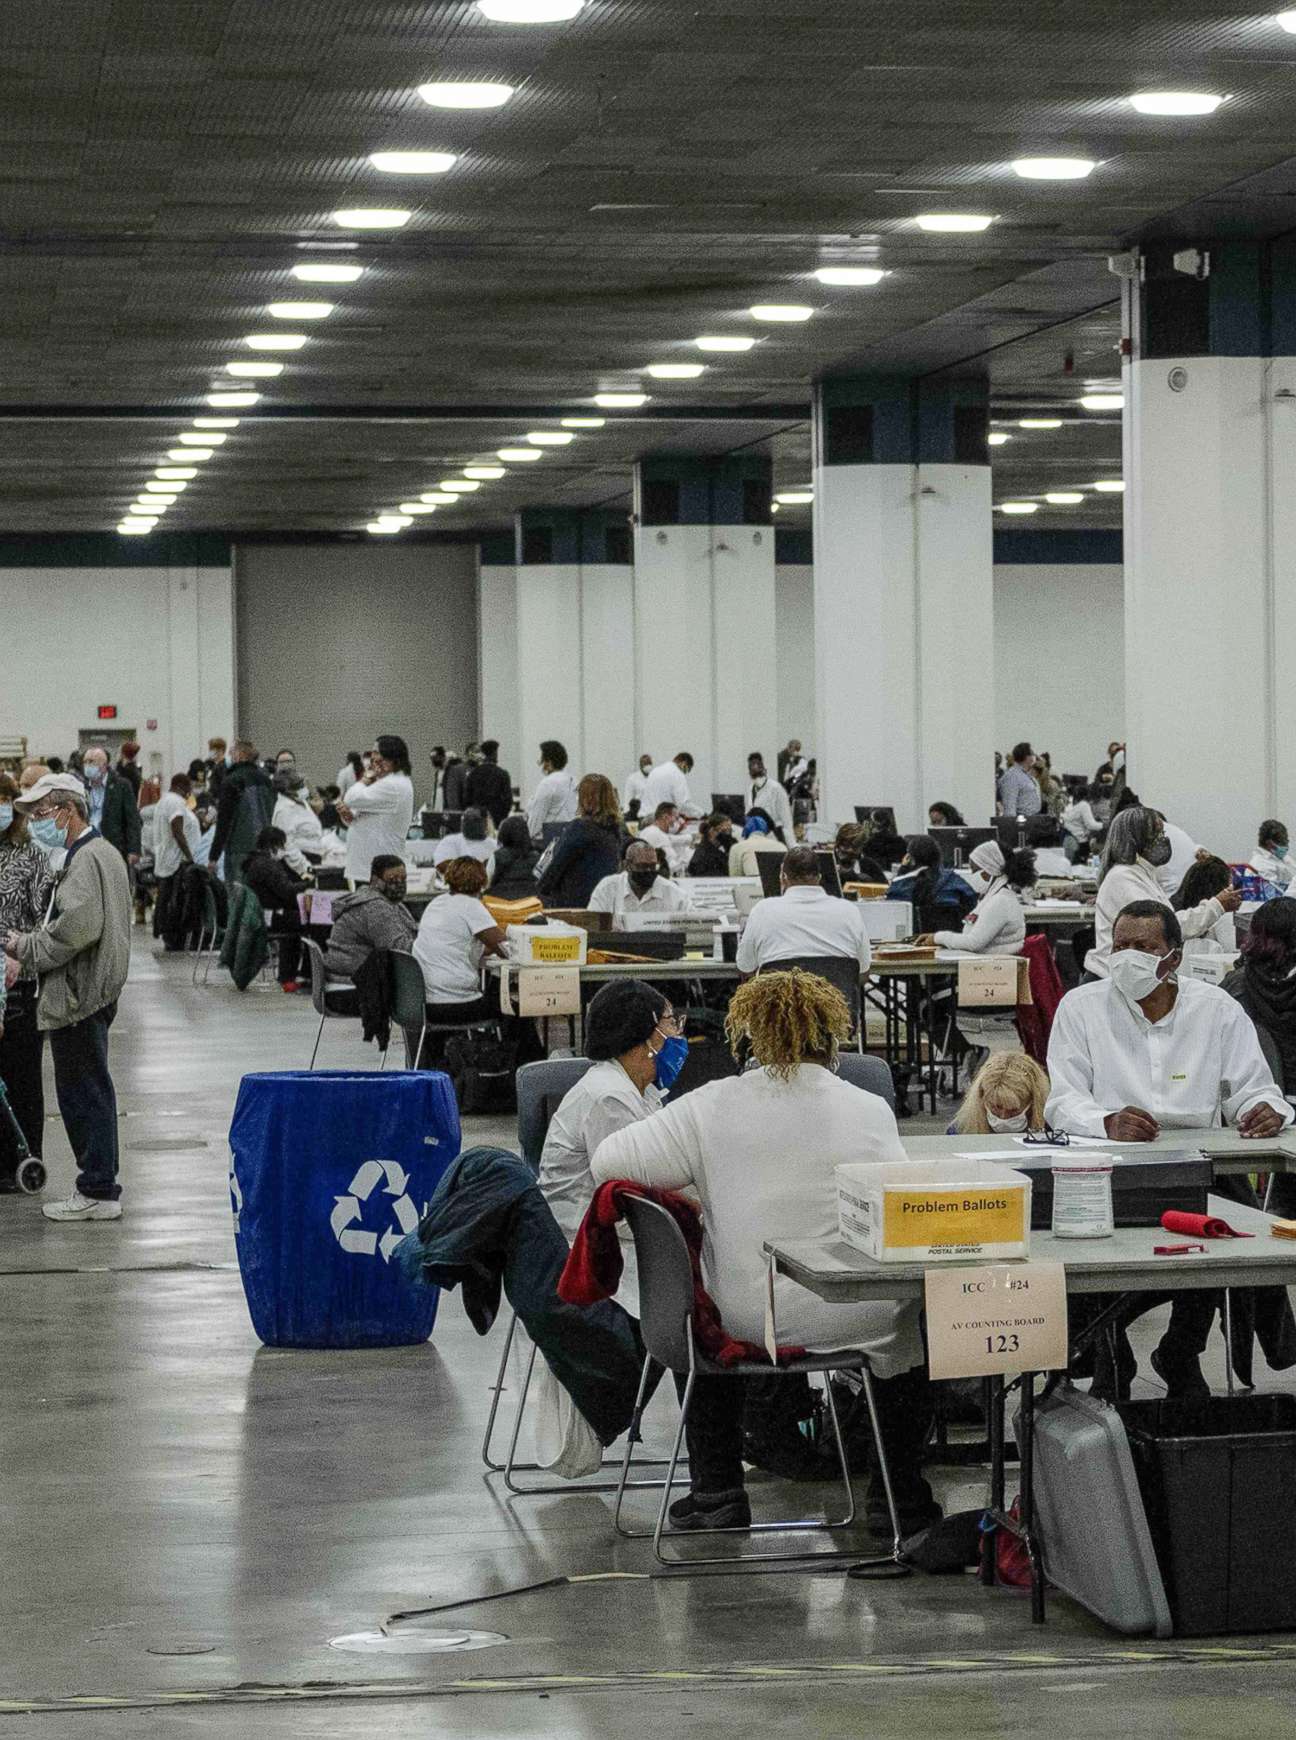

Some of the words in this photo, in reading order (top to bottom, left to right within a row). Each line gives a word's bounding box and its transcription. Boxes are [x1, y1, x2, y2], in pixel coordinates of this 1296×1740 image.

[903, 1200, 958, 1214] Problem
[963, 1199, 1007, 1211] Ballots
[962, 1282, 986, 1294] ICC
[1010, 1279, 1029, 1290] #24
[951, 1322, 964, 1330] AV
[965, 1319, 1013, 1329] COUNTING
[1014, 1317, 1045, 1327] BOARD
[985, 1334, 1020, 1354] 123
